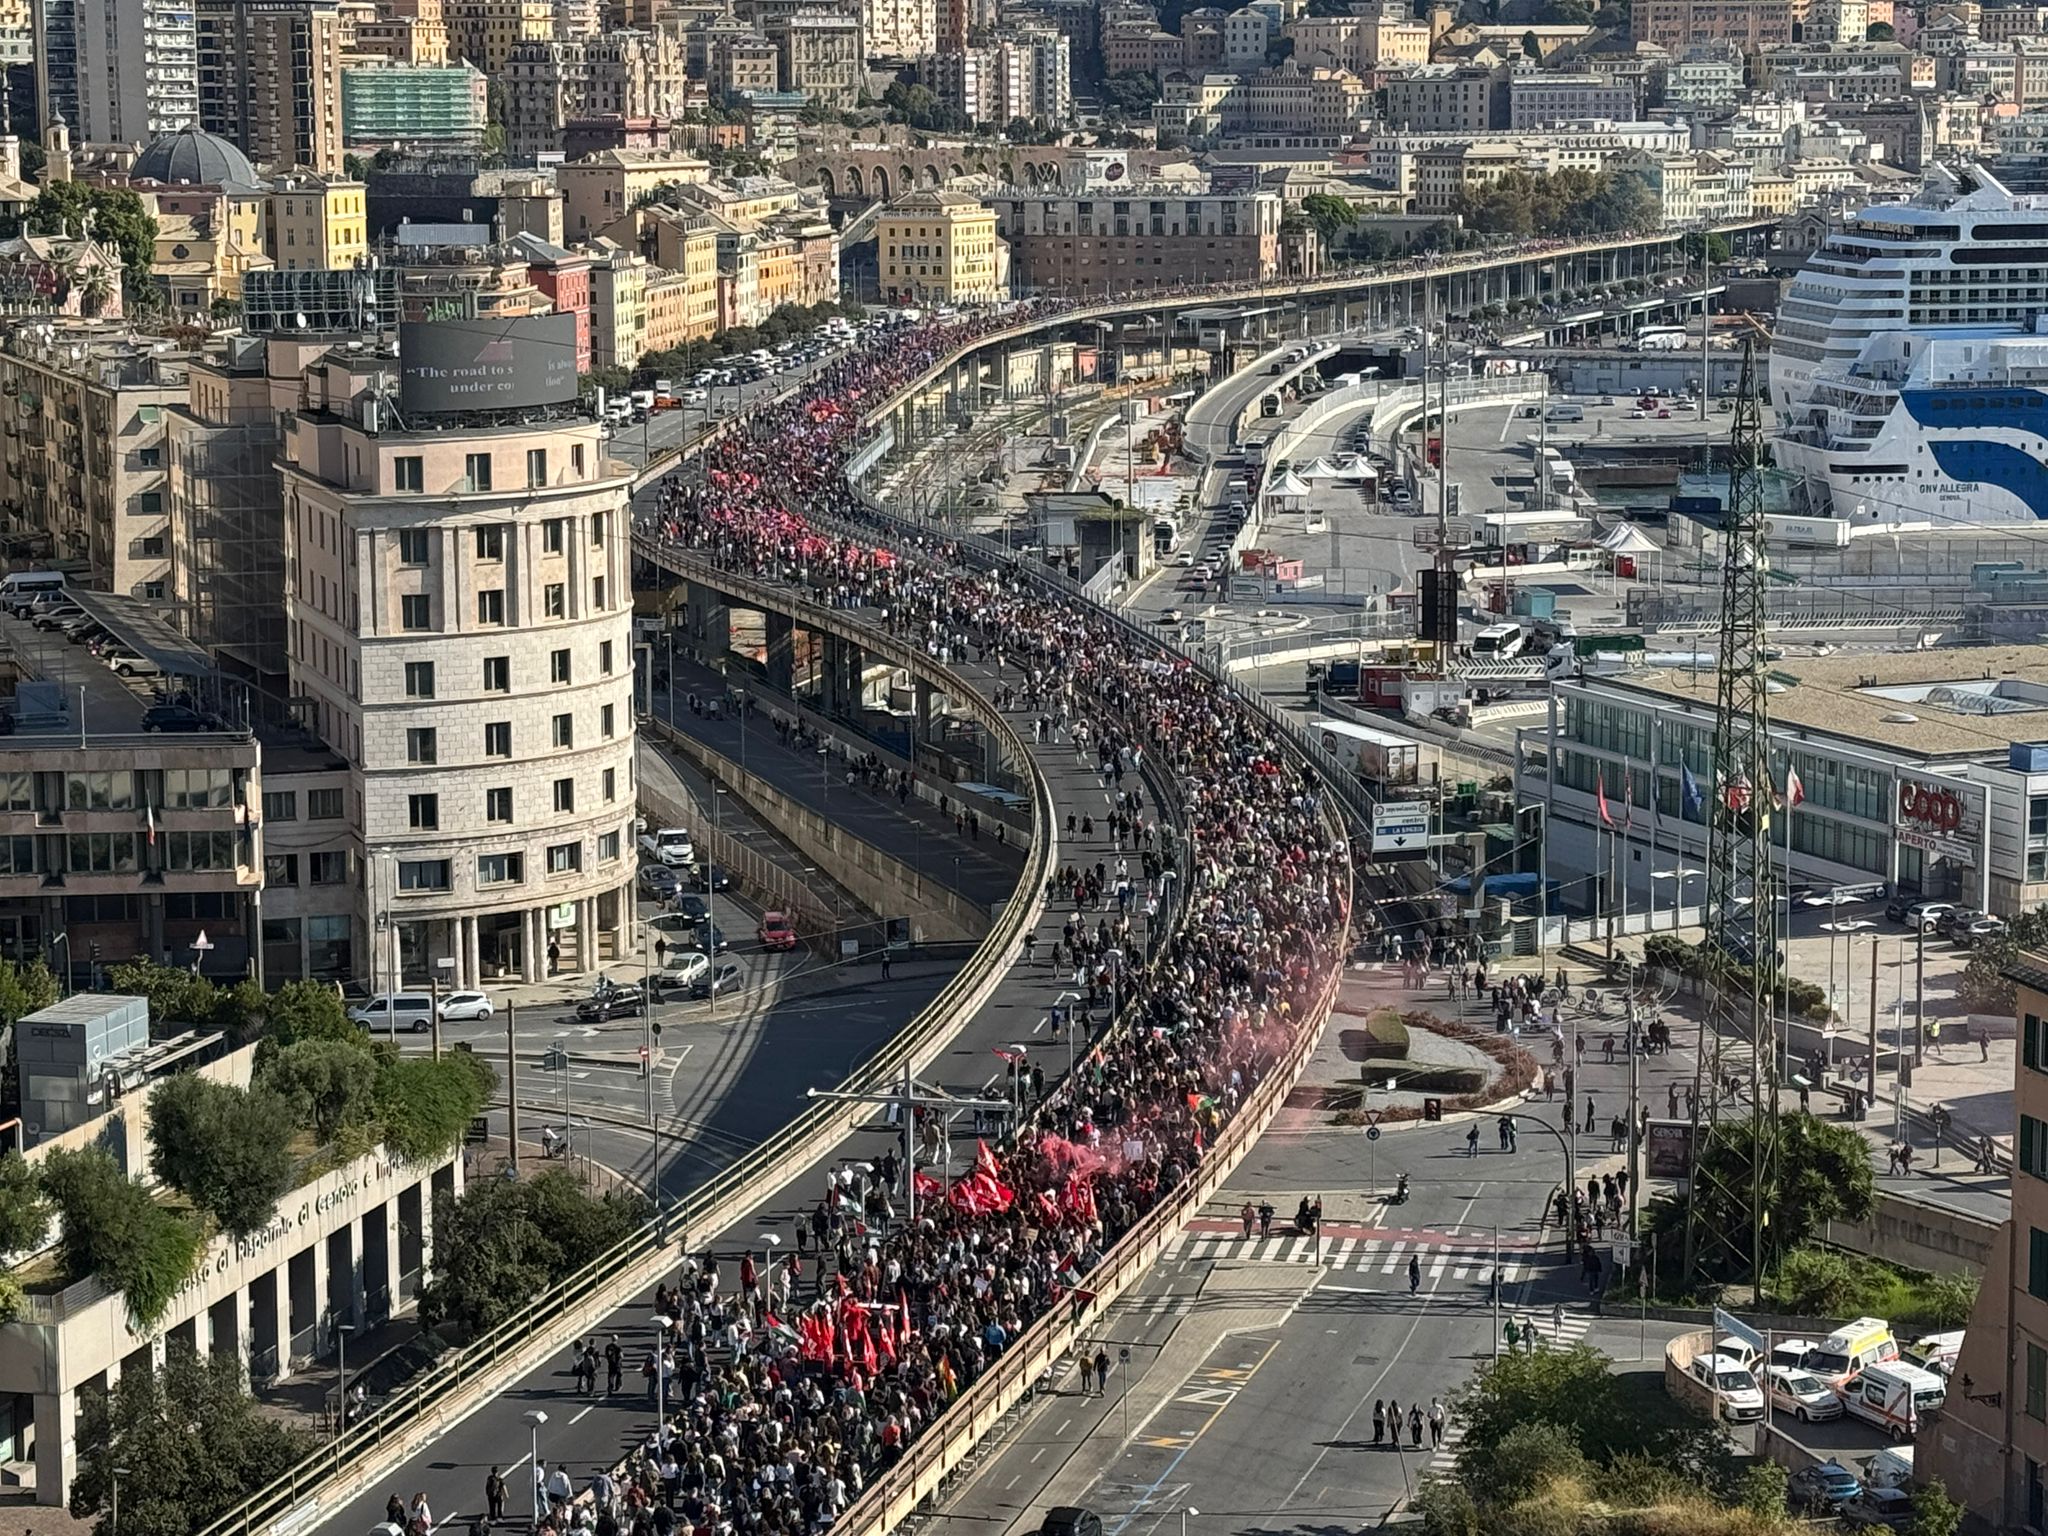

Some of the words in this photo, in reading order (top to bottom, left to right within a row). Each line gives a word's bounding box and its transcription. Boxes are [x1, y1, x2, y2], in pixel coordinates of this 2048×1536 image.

[452, 364, 487, 377] road
[491, 365, 504, 376] to
[507, 366, 514, 375] s
[450, 381, 494, 393] under
[1919, 484, 1938, 494] GNV
[1939, 483, 1980, 493] ALLEGRA
[1897, 831, 1937, 851] APERTO
[216, 1249, 229, 1274] di
[297, 1201, 310, 1226] di
[315, 1179, 360, 1215] Genova
[363, 1171, 373, 1188] e
